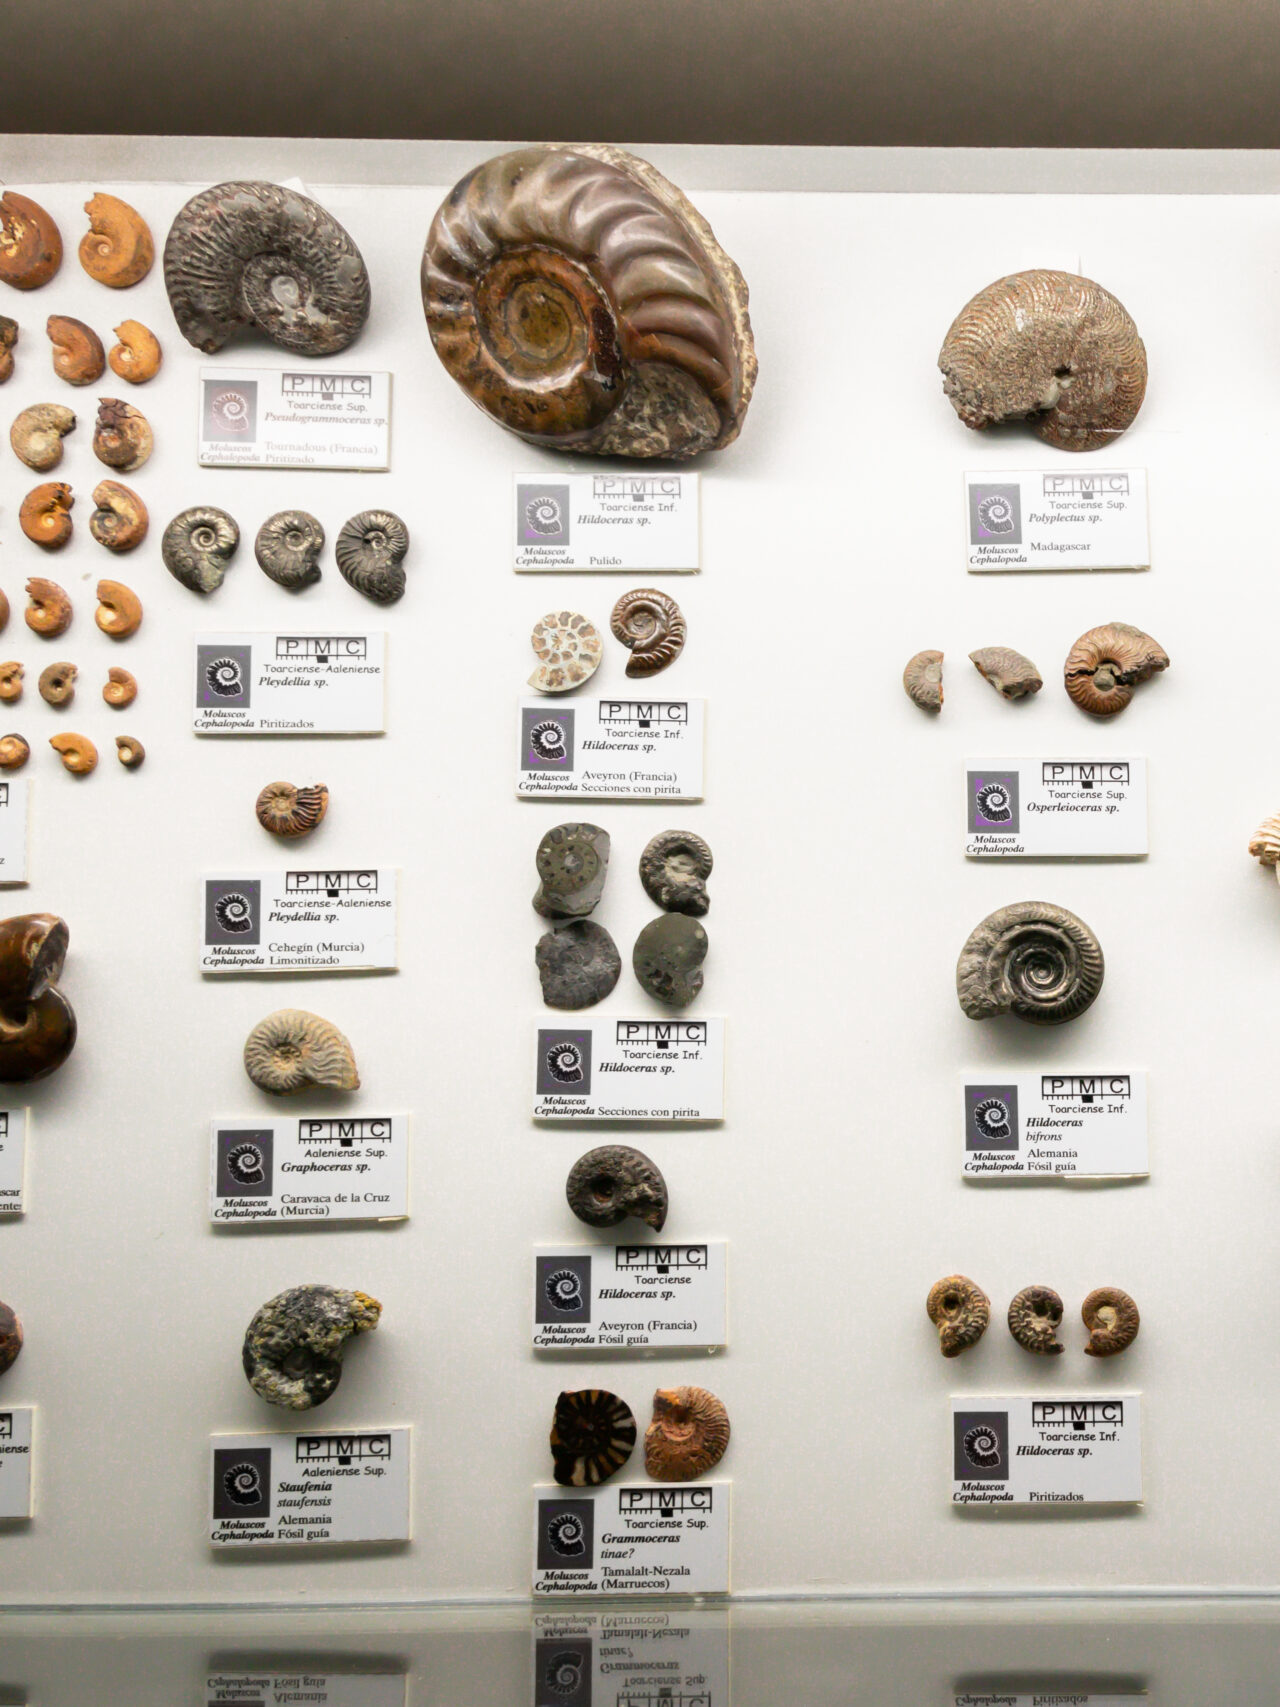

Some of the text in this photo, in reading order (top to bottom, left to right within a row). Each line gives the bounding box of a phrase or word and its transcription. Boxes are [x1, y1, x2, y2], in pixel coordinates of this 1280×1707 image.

[288, 400, 367, 412] Toarciense Sup.
[373, 417, 388, 426] sp.
[577, 515, 651, 526] Hildoceras sp.
[1029, 513, 1102, 524] Polyplectus sp.
[1030, 543, 1091, 552] Madagascar
[590, 557, 622, 565] Pulido
[264, 665, 380, 673] Toarciense-Aaleniense
[259, 677, 328, 687] Pleydellia sp.
[260, 720, 314, 728] Piritizados
[605, 729, 684, 739] Toarciense Inf.
[582, 741, 656, 752] Hildoceras sp.
[582, 771, 677, 782] Aveyron (Francia)
[1049, 790, 1127, 799] Toarciense Sup.
[1027, 803, 1120, 813] Osperleioceras sp.
[274, 899, 392, 908] Toarciense-Aaleniense
[268, 912, 339, 922] Pleydellia sp.
[317, 943, 364, 952] (Murcia)
[270, 956, 339, 964] Limonitizado
[599, 1063, 675, 1074] Hildoceras sp.
[1049, 1105, 1127, 1114] Toarciense Inf.
[1026, 1118, 1083, 1127] Hildoceras
[1026, 1131, 1062, 1142] bifrons
[305, 1149, 387, 1158] Aaleniense Sup.
[973, 1153, 1015, 1161] Moluscos
[1028, 1149, 1077, 1158] Alemania
[282, 1162, 371, 1172] Graphoceras sp.
[965, 1162, 1024, 1172] Cephalopoda
[1028, 1162, 1076, 1173] Fósil guía
[223, 1199, 268, 1207] Moluscos
[281, 1193, 390, 1203] Caravaca de la Cruz
[215, 1209, 277, 1218] Cephalopoda
[281, 1206, 329, 1216] (Murcia)
[635, 1275, 691, 1284] Toarciense
[599, 1289, 676, 1300] Hildoceras sp.
[599, 1321, 697, 1331] Aveyron (Francia)
[599, 1335, 648, 1346] Fósil guía
[1016, 1446, 1093, 1458] Hildoceras sp.
[302, 1467, 386, 1477] Aaleniense Sup.
[278, 1482, 332, 1493] Staufenia
[1029, 1492, 1084, 1501] Piritizados
[277, 1497, 331, 1509] staufensis
[279, 1515, 332, 1525] Alemania
[625, 1519, 708, 1530] Toarciense Sup.
[278, 1529, 329, 1540] Fósil guía
[602, 1534, 680, 1543] Grammoceras
[601, 1549, 635, 1558] tinae?
[602, 1566, 690, 1576] Tamalalt-Nezala
[601, 1579, 669, 1590] (Marruecos)
